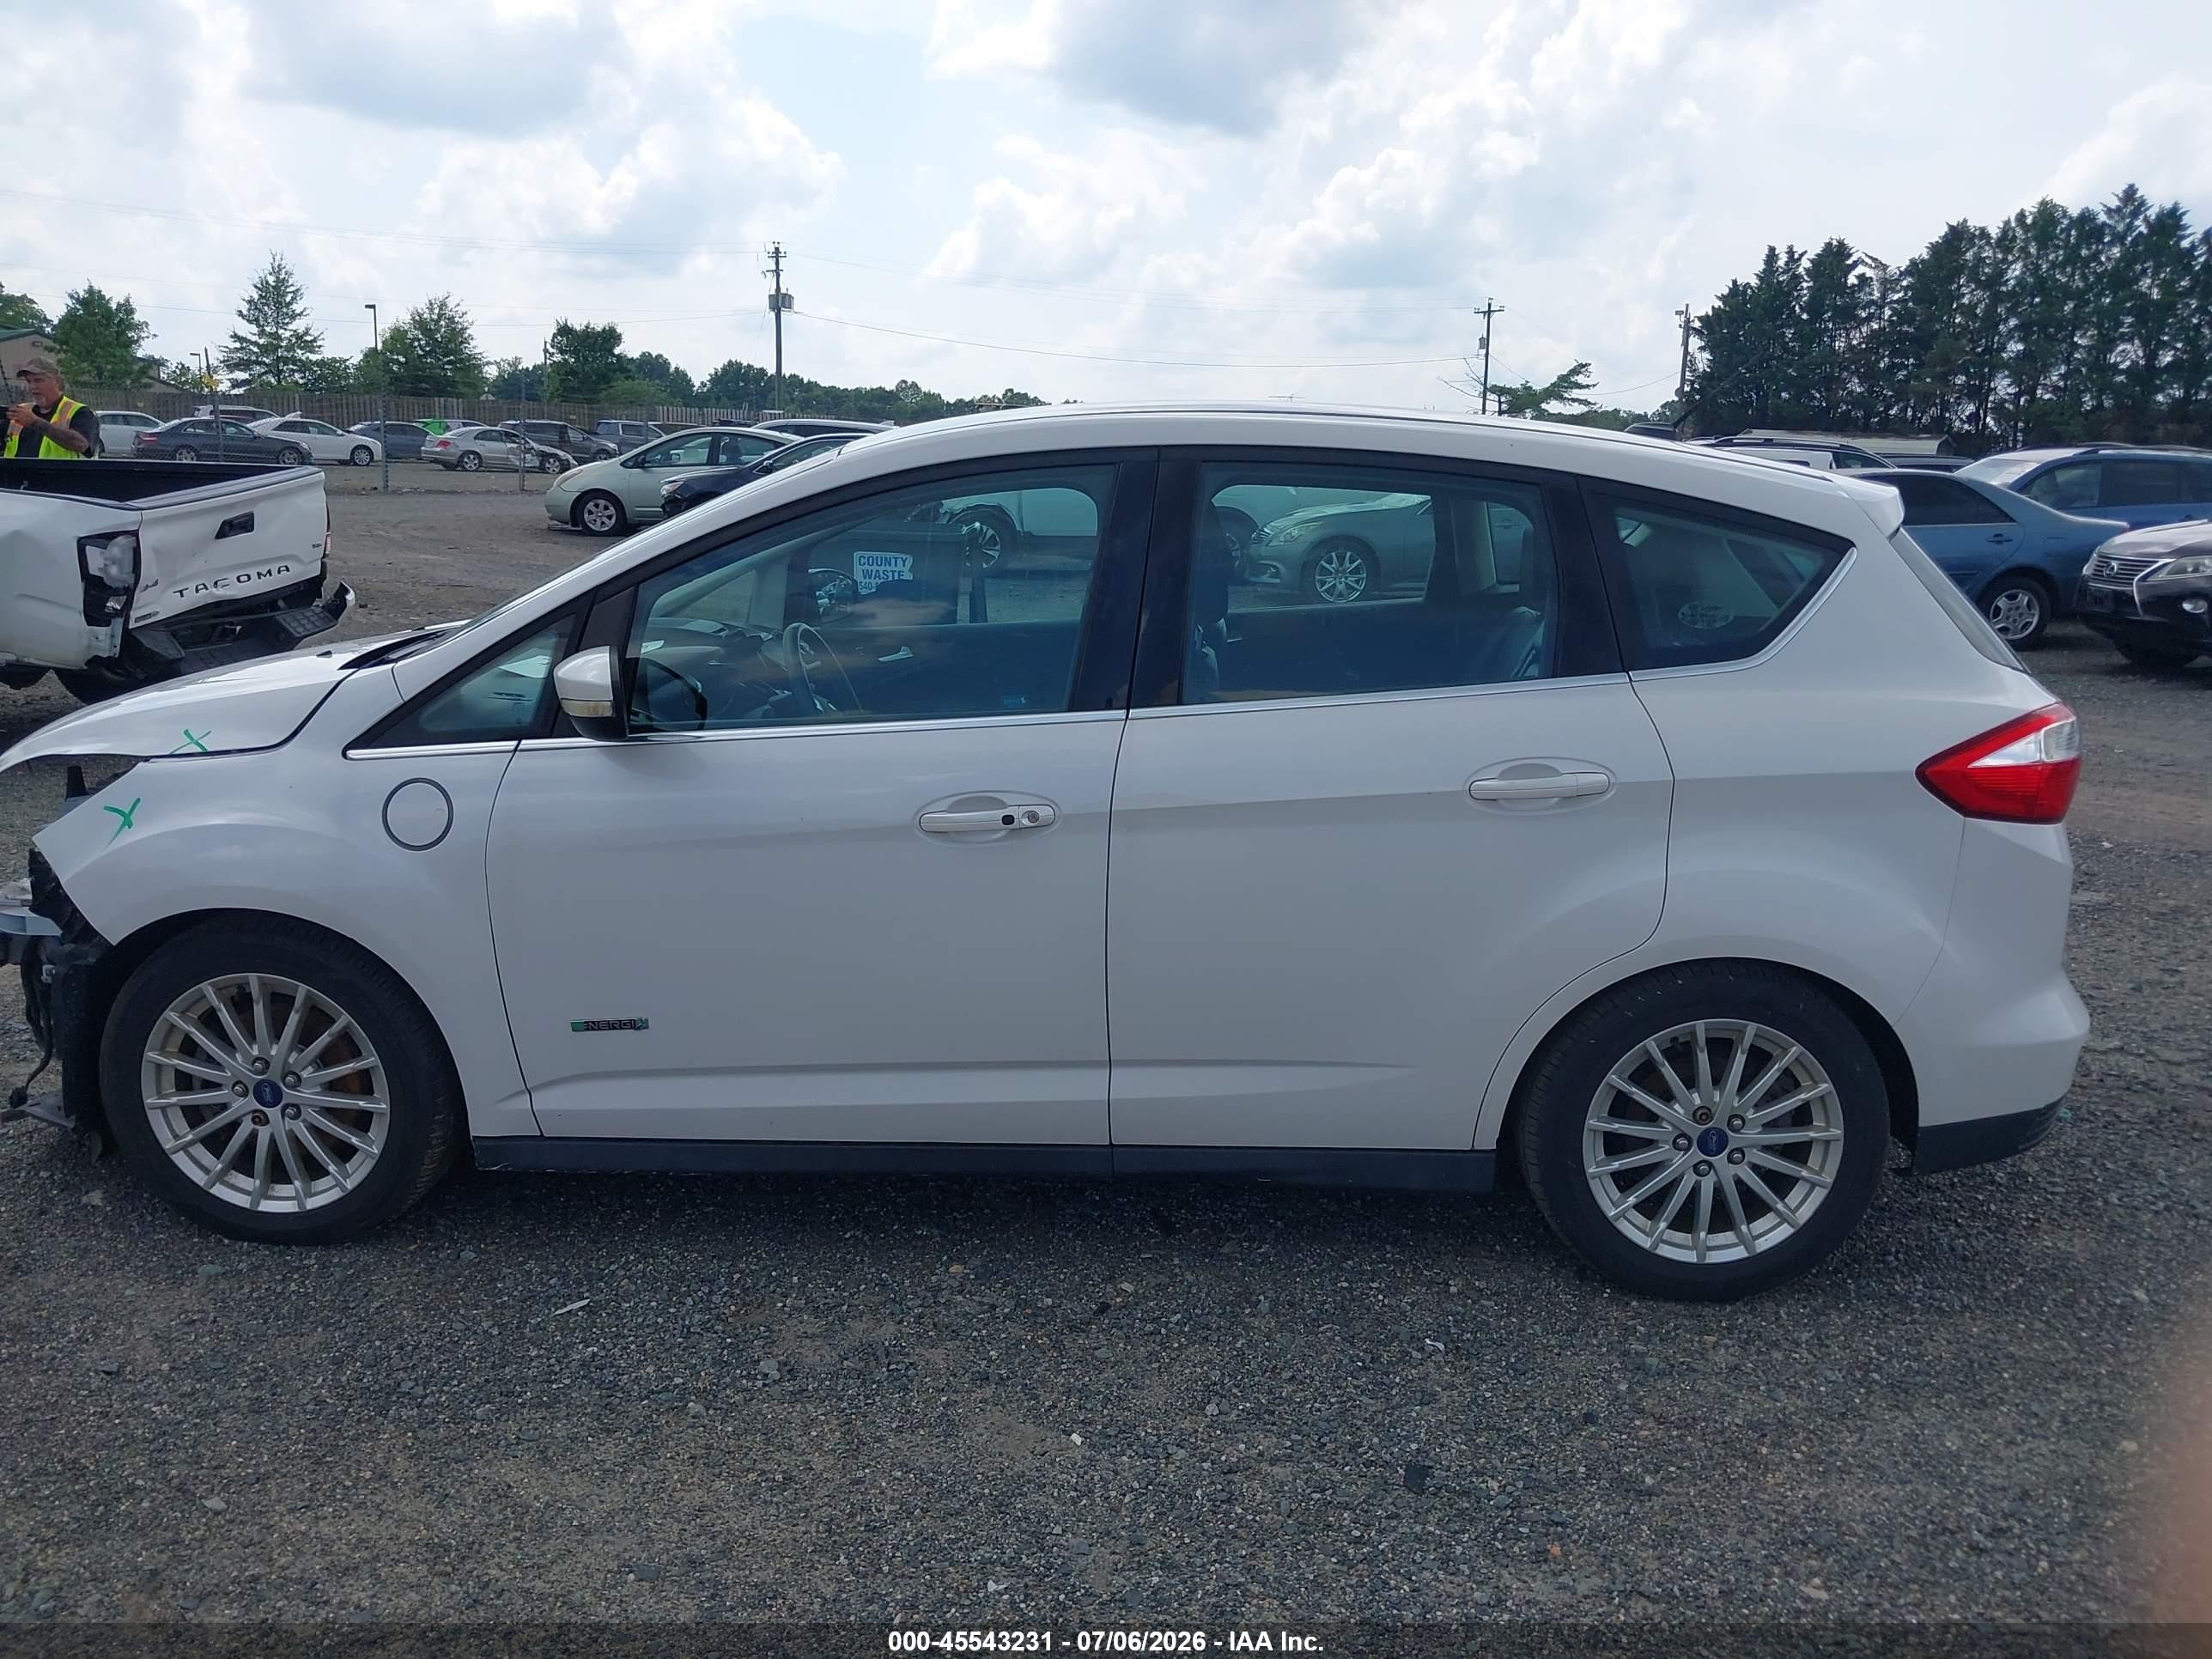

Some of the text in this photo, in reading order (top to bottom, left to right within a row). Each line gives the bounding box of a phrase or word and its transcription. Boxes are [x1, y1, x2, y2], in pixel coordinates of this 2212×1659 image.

[859, 556, 907, 567] COUNTY
[862, 569, 904, 580] WASTE
[173, 564, 291, 599] TACOMA
